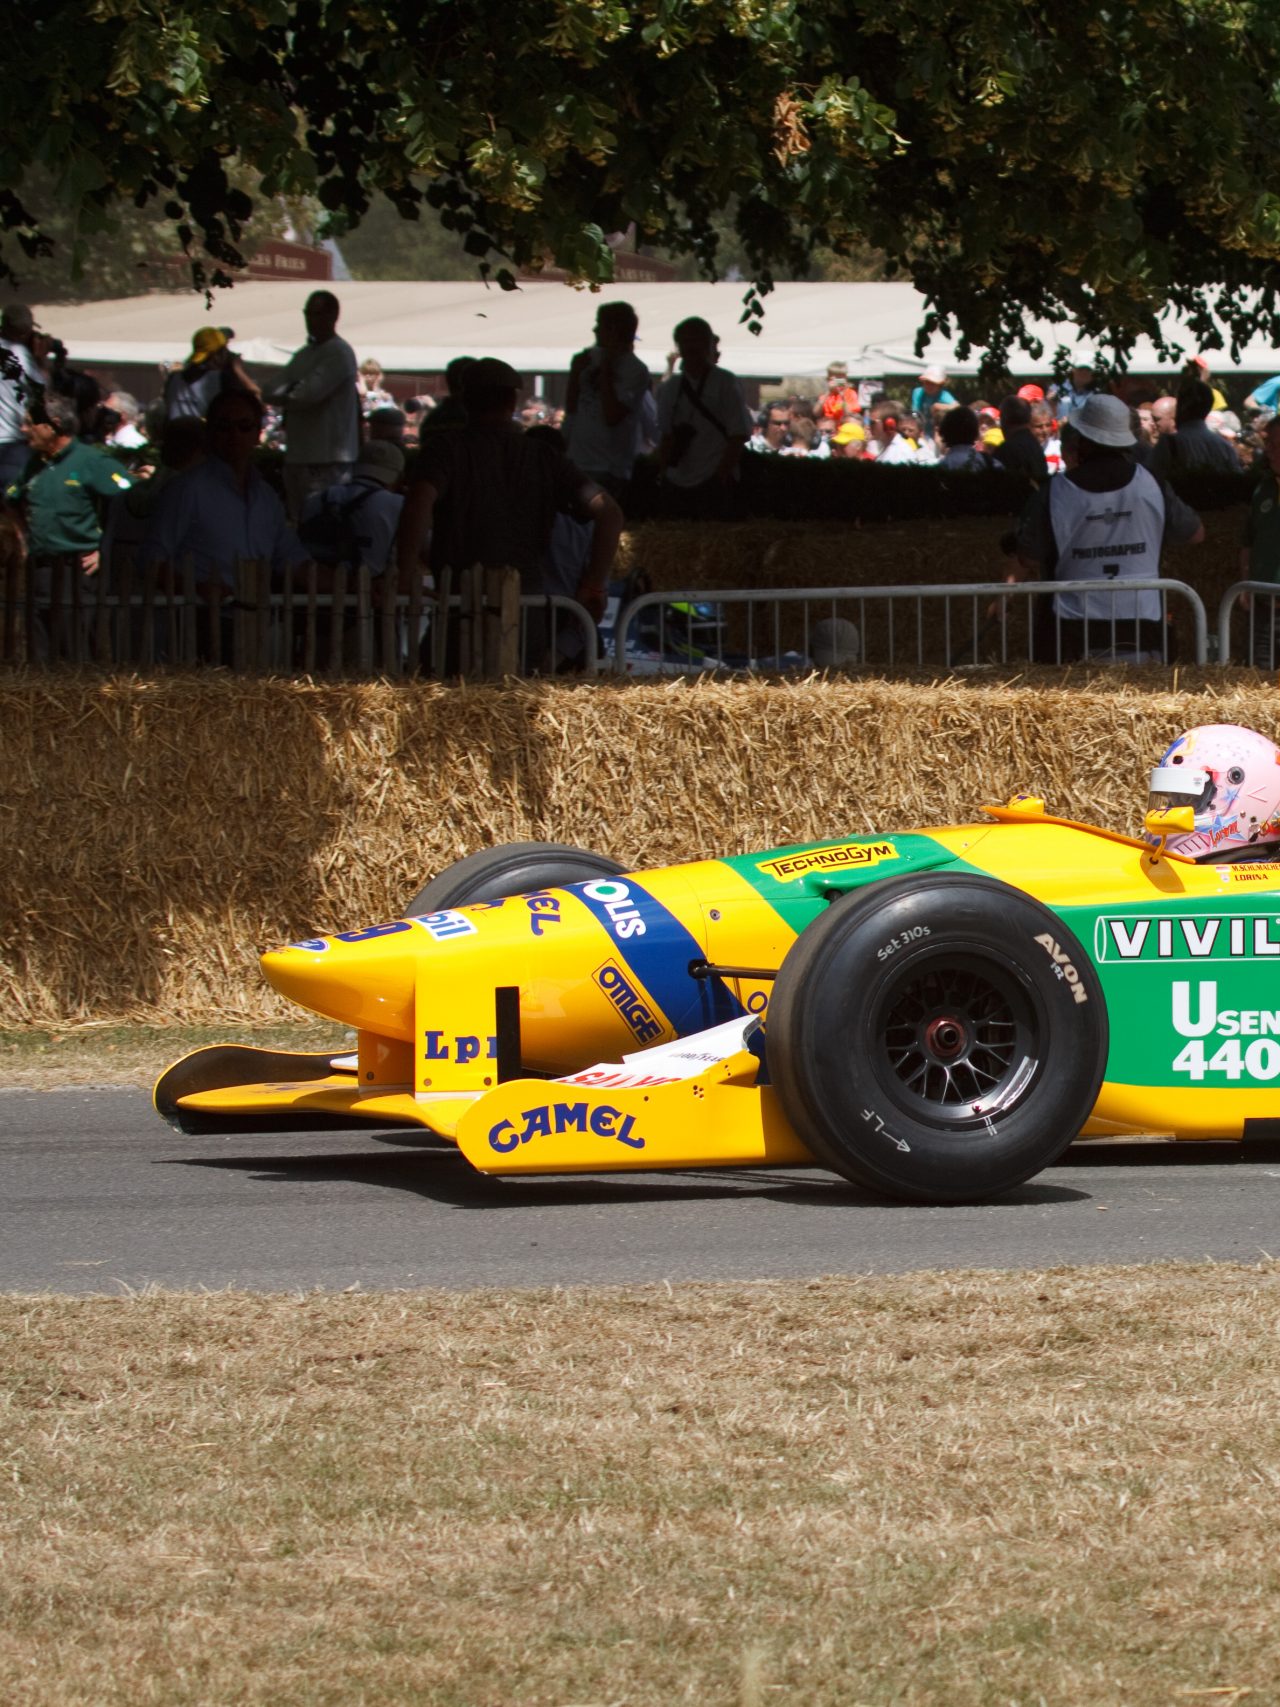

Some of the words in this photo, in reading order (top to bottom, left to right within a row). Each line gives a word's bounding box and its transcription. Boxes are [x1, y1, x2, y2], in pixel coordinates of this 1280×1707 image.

[1234, 873, 1269, 882] LORINA
[877, 935, 903, 962] Set
[1033, 932, 1088, 1004] AVON
[488, 1102, 645, 1153] CAMEL
